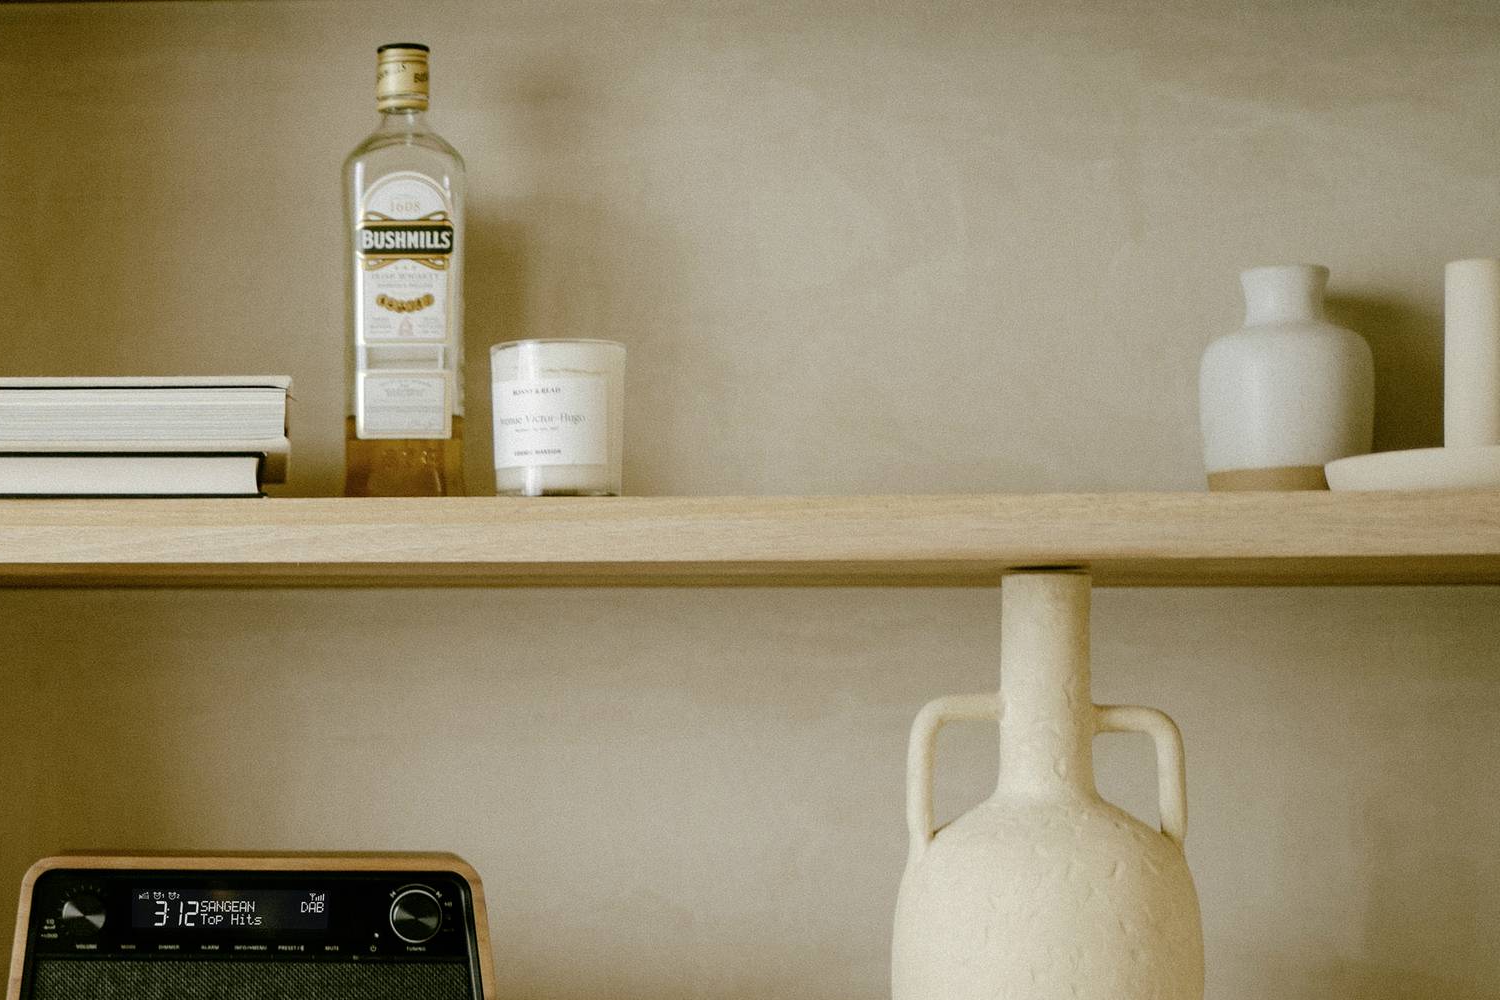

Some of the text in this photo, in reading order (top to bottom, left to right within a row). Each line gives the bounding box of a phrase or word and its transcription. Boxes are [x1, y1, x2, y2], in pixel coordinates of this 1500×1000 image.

[362, 229, 451, 249] BUSHMILLS
[200, 901, 255, 913] SANGEAN
[300, 901, 325, 913] DAB
[230, 914, 262, 926] Hits
